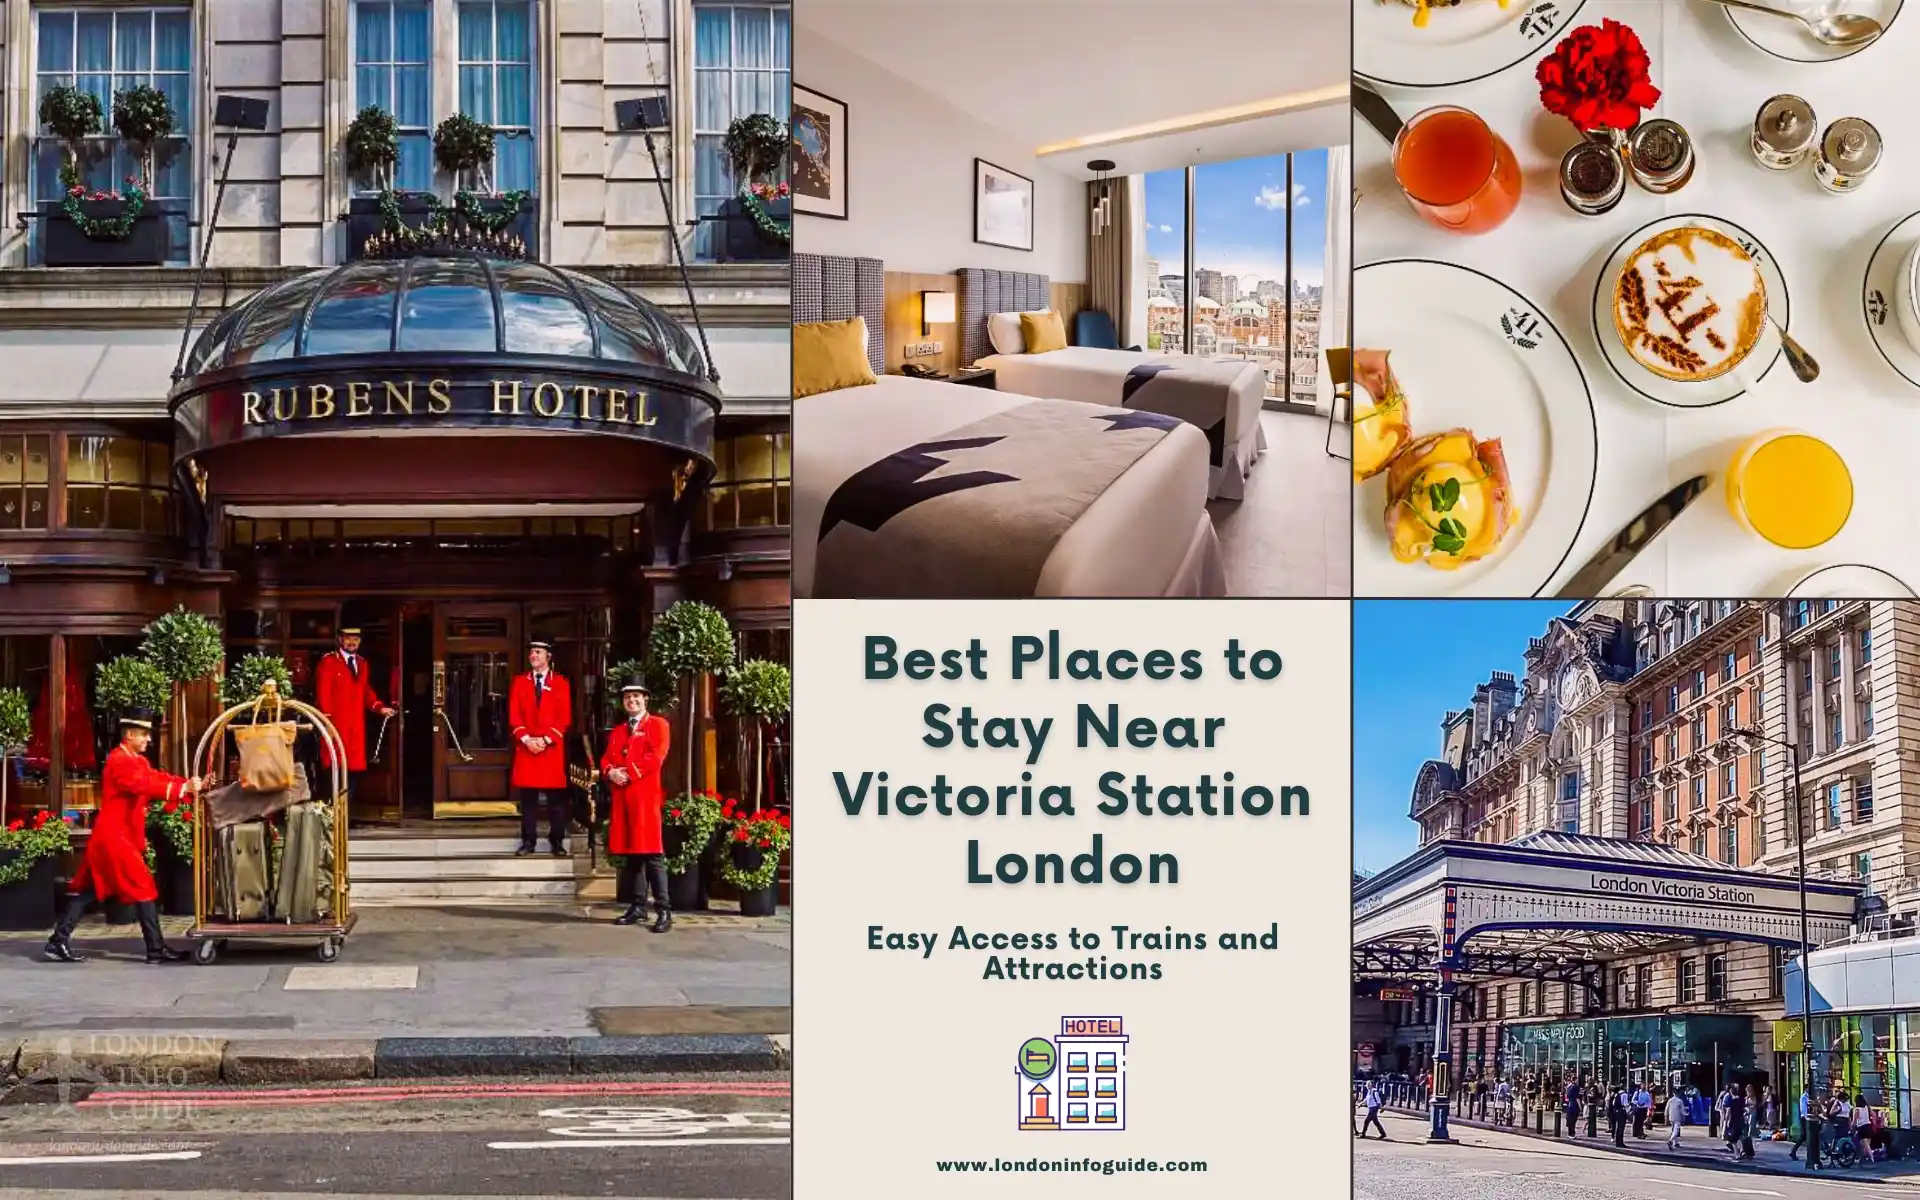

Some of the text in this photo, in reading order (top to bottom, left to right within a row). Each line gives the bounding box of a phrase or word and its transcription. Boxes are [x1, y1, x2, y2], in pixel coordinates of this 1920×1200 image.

[242, 378, 658, 426] RUBENS HOTEL
[1591, 873, 1755, 904] London Victoria Station
[1566, 1027, 1585, 1039] FOOD
